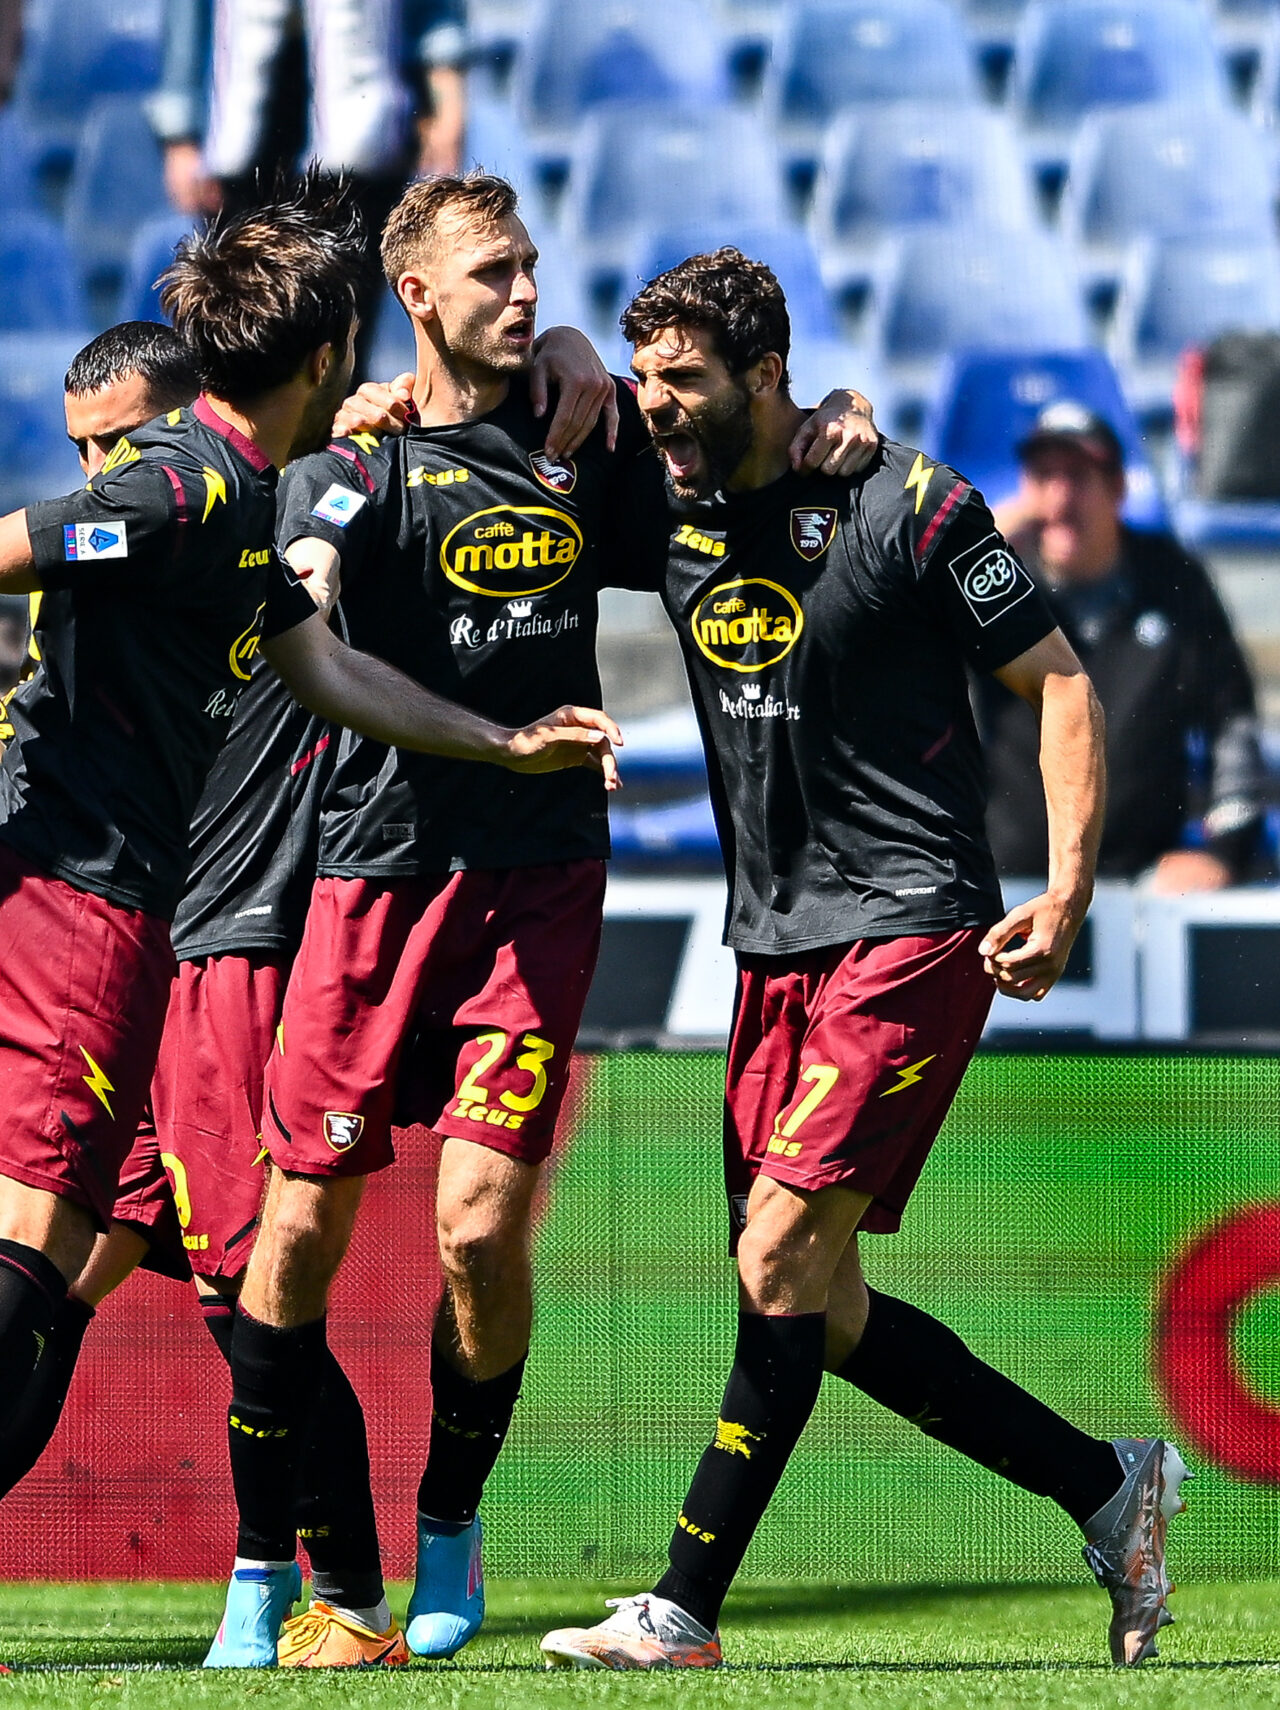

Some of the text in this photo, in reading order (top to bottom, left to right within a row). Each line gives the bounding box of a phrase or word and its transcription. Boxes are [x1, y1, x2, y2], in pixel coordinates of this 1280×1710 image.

[406, 466, 469, 487] Zeus
[474, 521, 515, 539] caffè
[674, 524, 726, 557] Zeus
[800, 539, 819, 548] 1919
[238, 549, 270, 568] Zeu
[454, 531, 576, 573] motta
[972, 551, 1011, 596] eté
[713, 597, 747, 615] caffè
[450, 613, 481, 648] Re
[701, 607, 793, 646] motta
[456, 1032, 555, 1112] 23
[451, 1099, 525, 1130] Zeus
